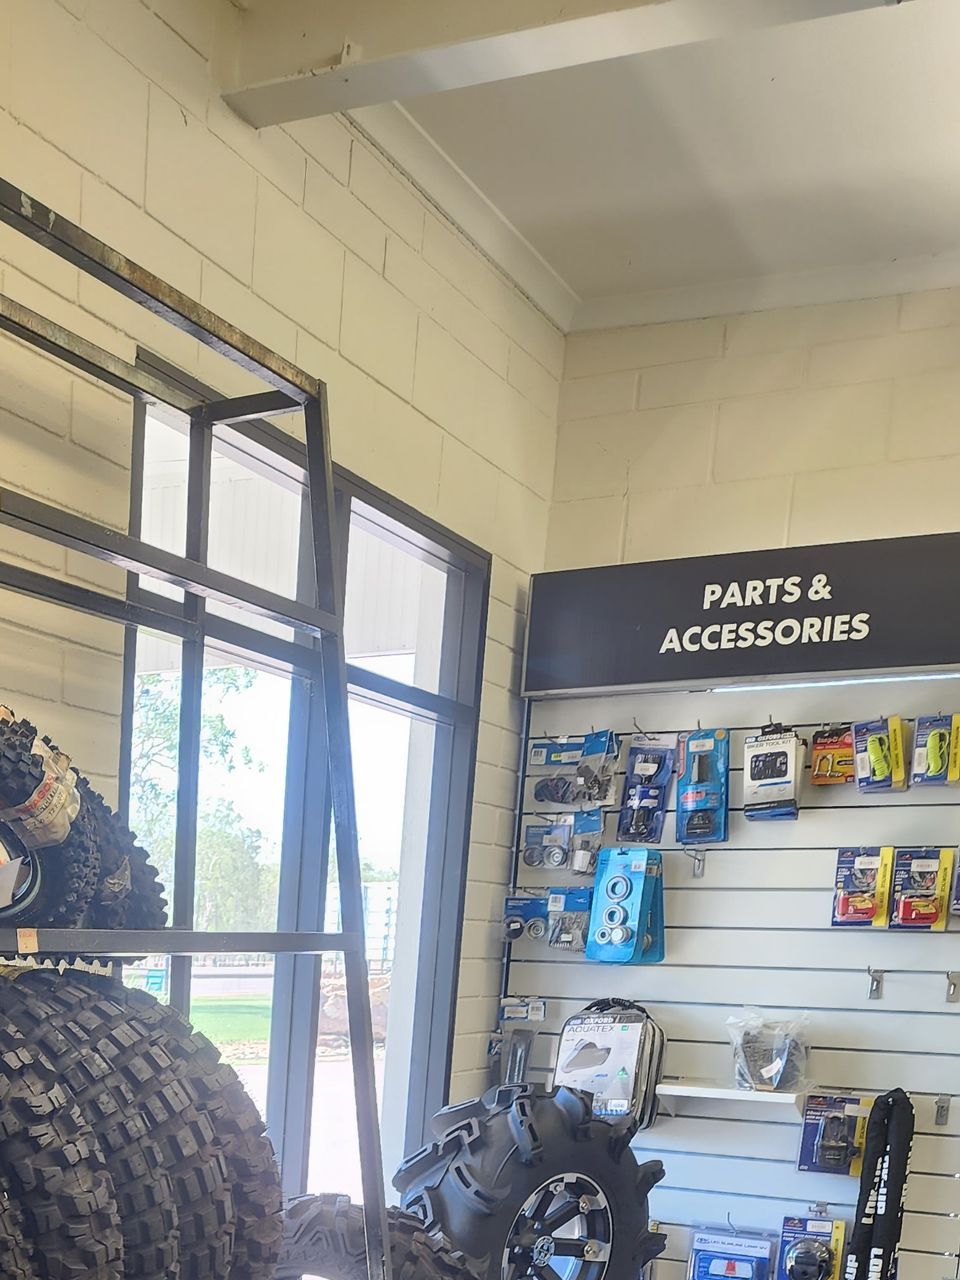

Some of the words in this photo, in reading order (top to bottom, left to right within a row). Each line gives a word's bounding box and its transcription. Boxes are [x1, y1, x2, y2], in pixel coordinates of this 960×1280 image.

[702, 576, 802, 610] PARTS
[807, 573, 832, 601] &
[658, 612, 871, 654] ACCESSORIES
[567, 1025, 616, 1034] AQUATEX
